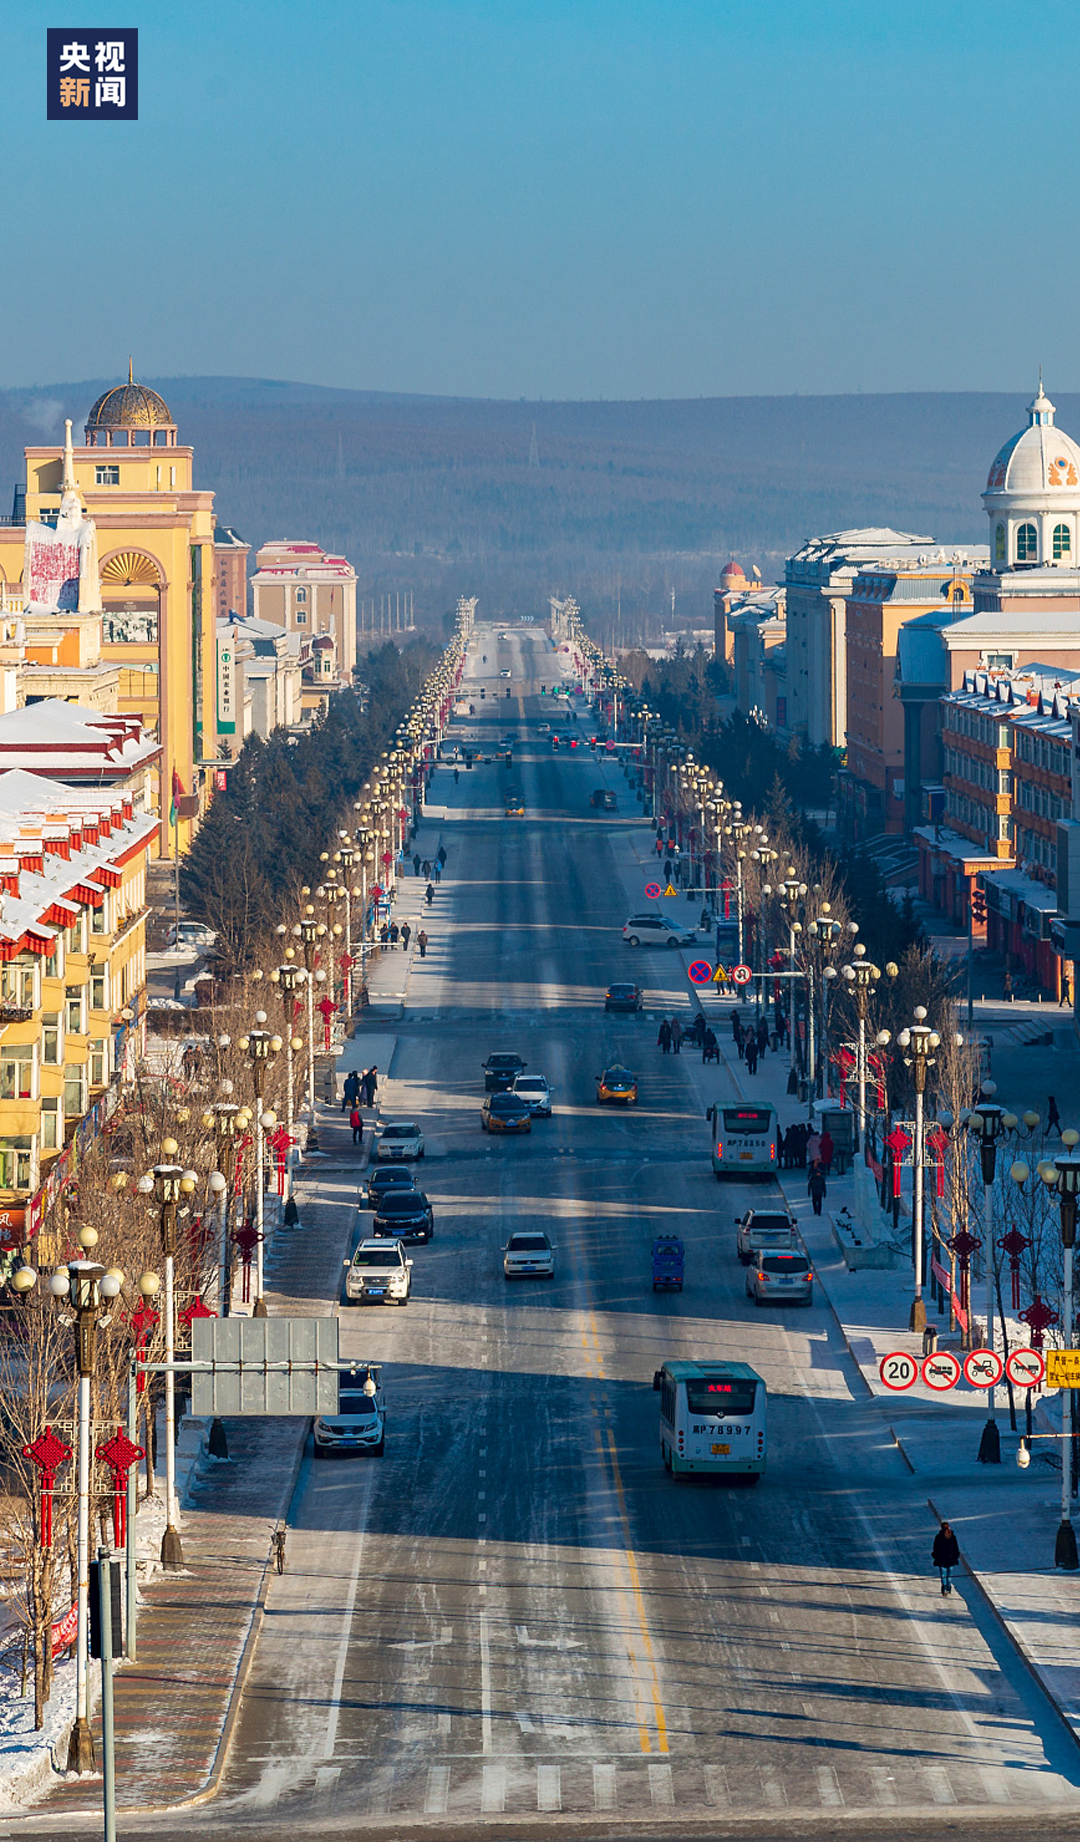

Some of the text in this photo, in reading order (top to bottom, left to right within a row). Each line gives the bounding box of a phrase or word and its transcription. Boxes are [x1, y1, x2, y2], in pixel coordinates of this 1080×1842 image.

[222, 665, 230, 713] 中国农业银行
[889, 1362, 910, 1379] 20
